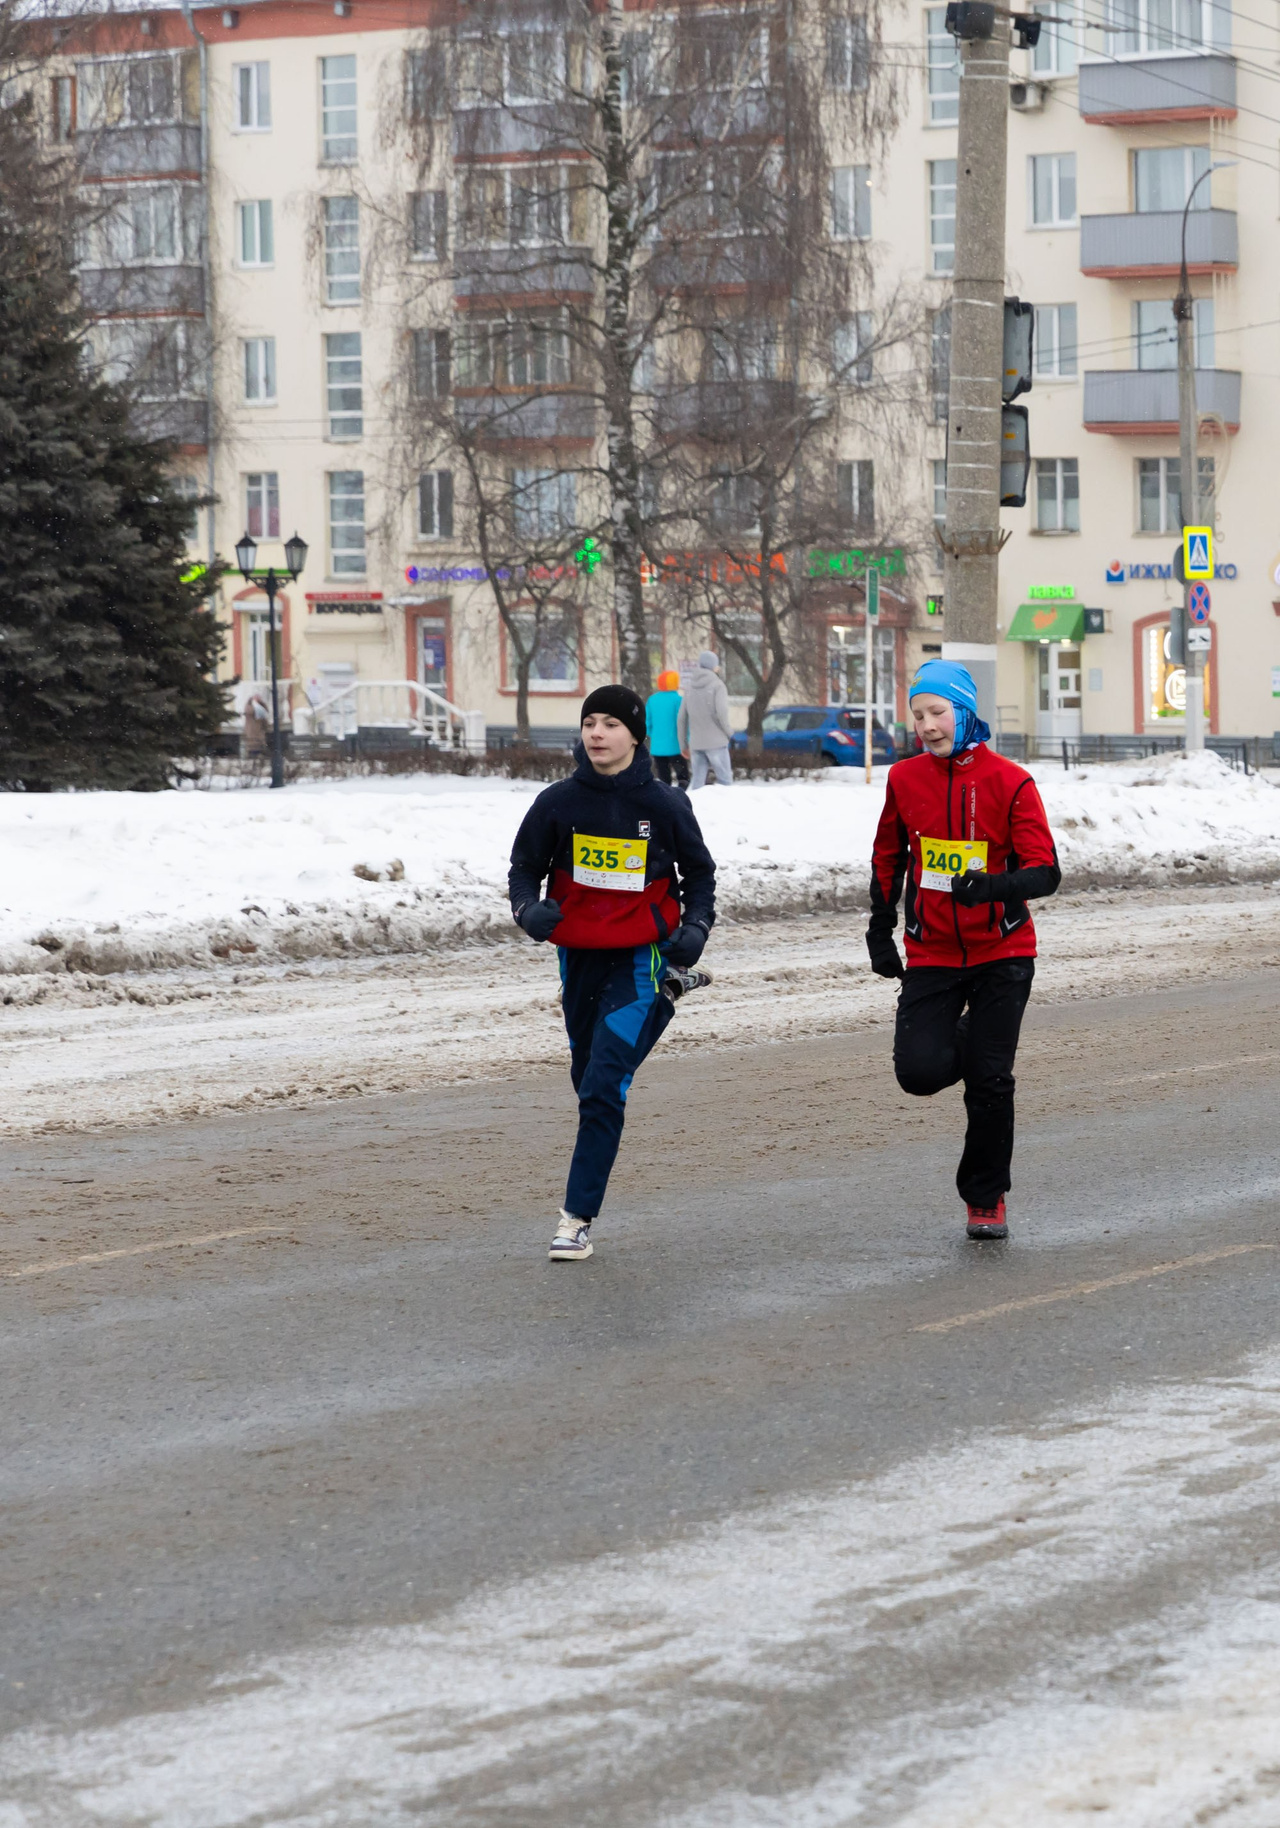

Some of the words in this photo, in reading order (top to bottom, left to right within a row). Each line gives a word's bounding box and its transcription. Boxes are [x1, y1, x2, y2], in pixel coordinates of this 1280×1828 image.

[1129, 563, 1237, 580] ИЖМКО
[580, 846, 619, 869] 235
[926, 849, 962, 872] 240
